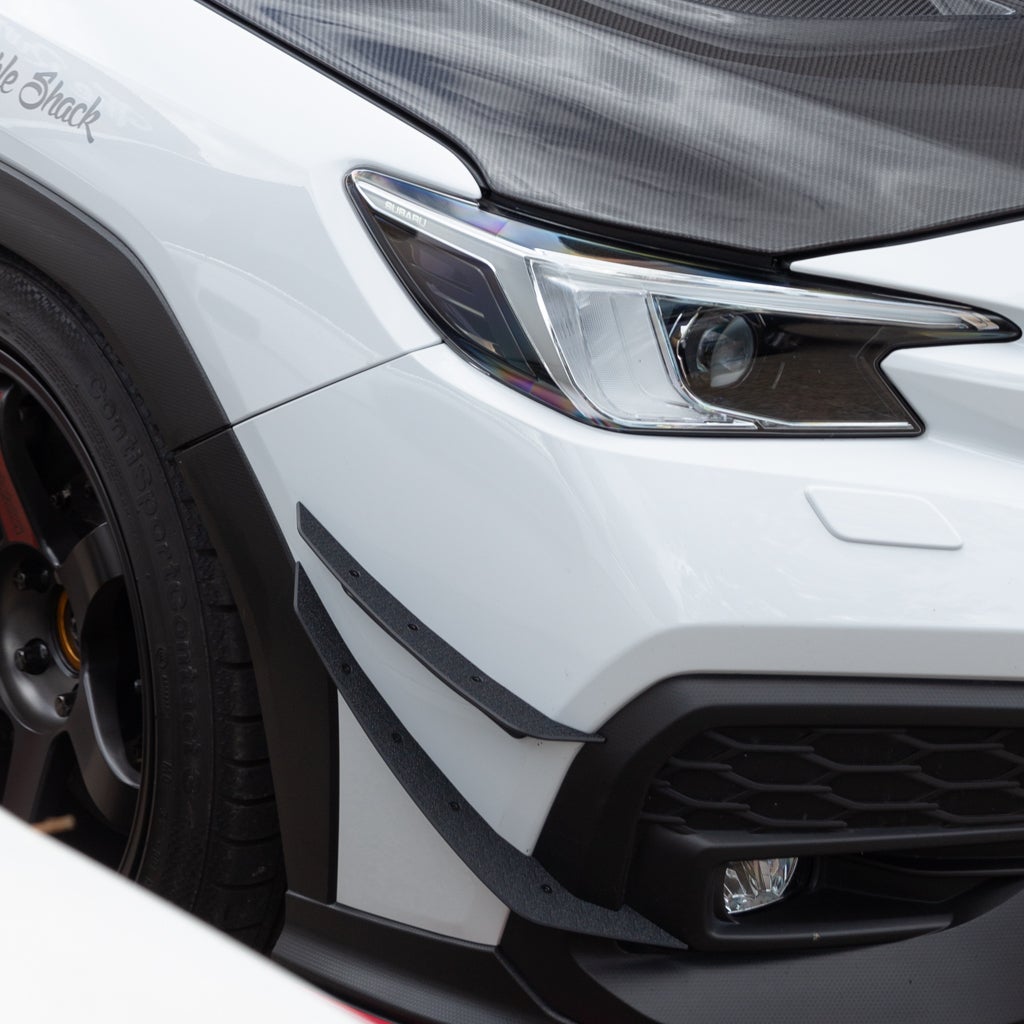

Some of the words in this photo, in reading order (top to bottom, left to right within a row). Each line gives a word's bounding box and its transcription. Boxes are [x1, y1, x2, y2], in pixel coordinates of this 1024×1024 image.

[0, 52, 18, 93] le
[19, 71, 102, 144] Shack
[385, 201, 427, 227] SUBARU
